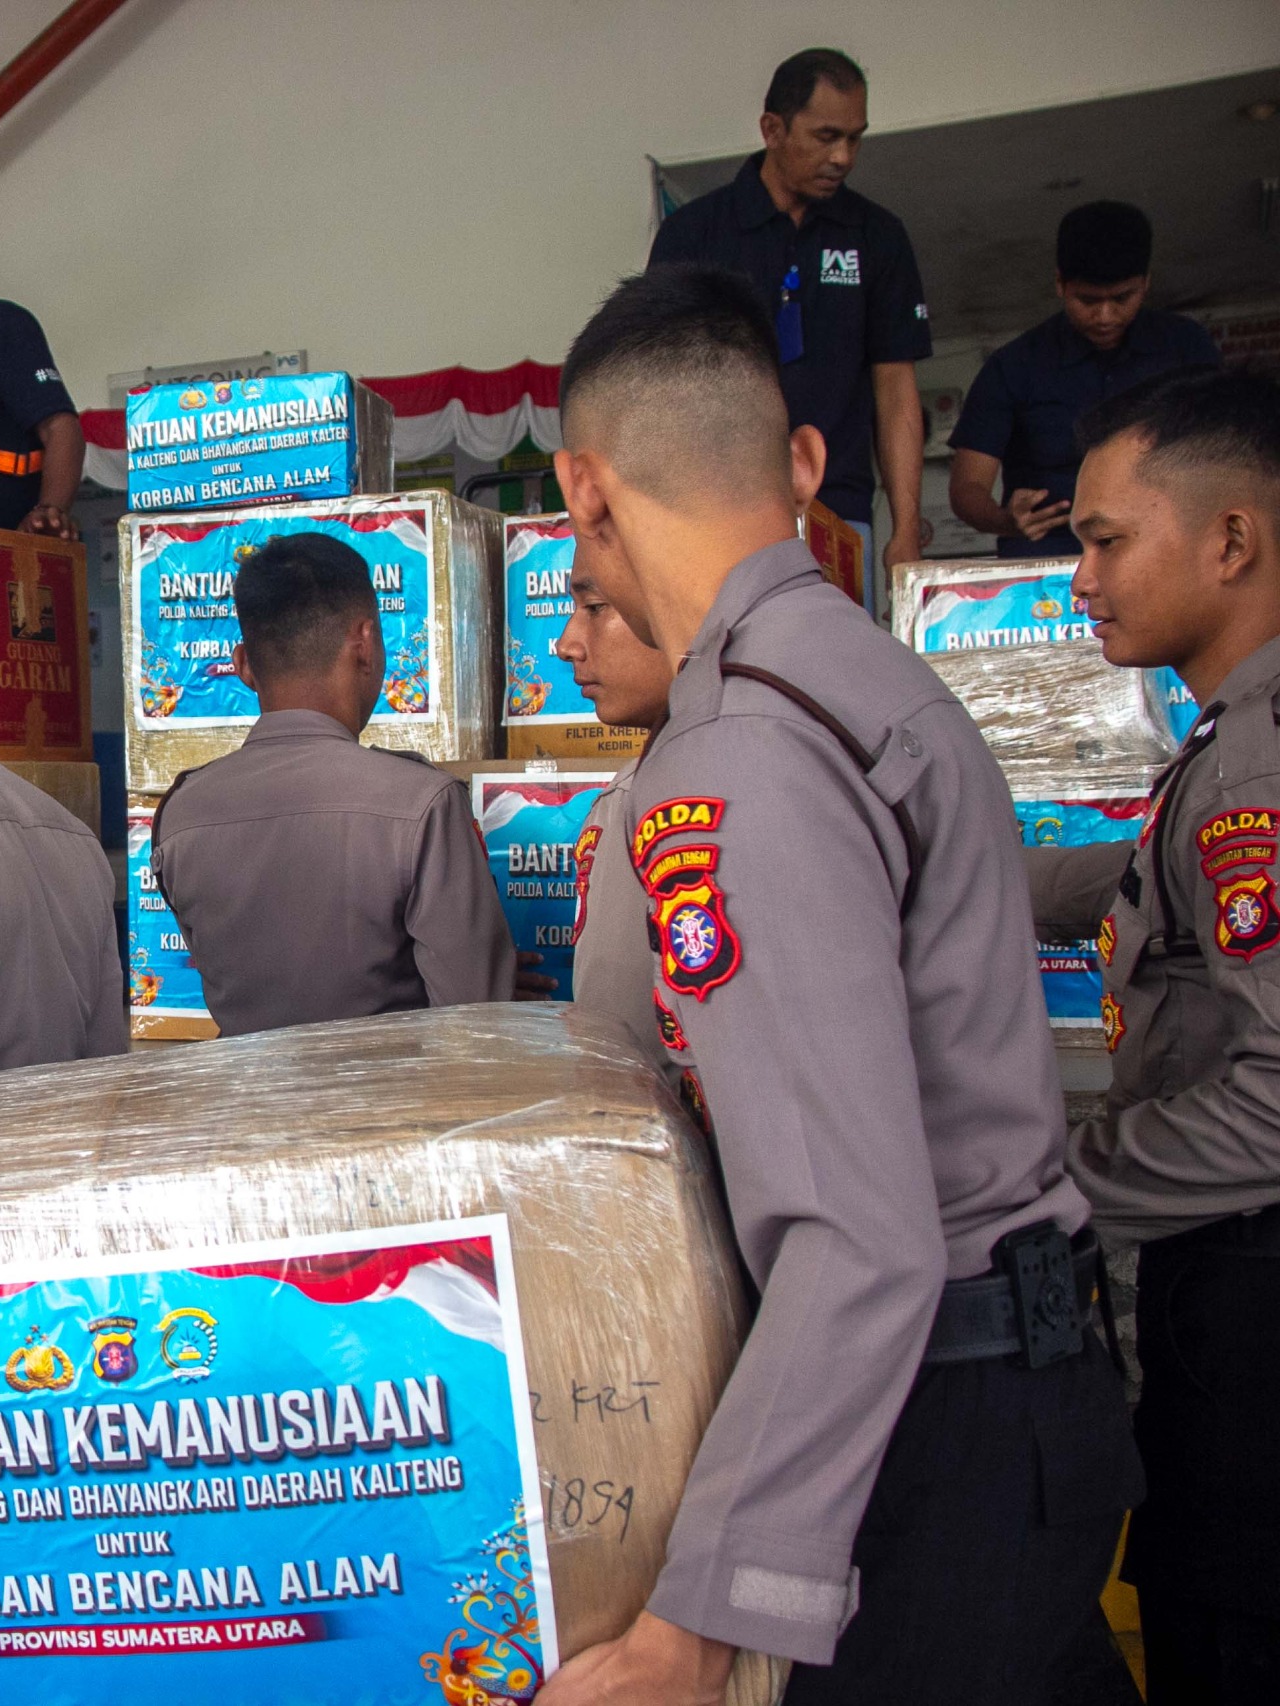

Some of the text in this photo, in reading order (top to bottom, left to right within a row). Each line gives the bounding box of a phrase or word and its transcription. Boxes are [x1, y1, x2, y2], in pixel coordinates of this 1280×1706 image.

[127, 394, 348, 451] NTUAN KEMANUSIAAN
[137, 450, 177, 469] KALTENG
[180, 448, 200, 463] DAN
[202, 437, 268, 460] BHAYANGKARI
[270, 430, 309, 450] DAERAH
[212, 463, 242, 475] UNTUK
[131, 465, 331, 509] KORBAN BENCANA ALAM
[160, 572, 237, 599] BANTUA
[159, 606, 186, 619] POLDA
[189, 603, 228, 619] KALTENG
[525, 602, 555, 617] POLDA
[7, 642, 62, 663] GUDANG
[180, 639, 243, 659] KORBA
[566, 727, 604, 739] FILTER
[597, 740, 633, 751] KEDIRI
[635, 804, 711, 855] POLDA
[1201, 813, 1272, 845] POLDA
[682, 850, 711, 866] TENGAH
[1244, 847, 1272, 858] TENGAH
[507, 882, 577, 897] POLDA KALT
[140, 897, 166, 911] POLDA
[1050, 960, 1088, 969] UTARA
[63, 1375, 445, 1463] KEMANUSIAAN
[14, 1487, 62, 1517] DAN
[69, 1477, 236, 1516] BHAYANGKARI
[243, 1468, 343, 1506] DAERAH
[350, 1456, 461, 1496] KALTENG
[95, 1531, 170, 1555] UNTUK
[69, 1565, 260, 1611] BENCANA
[280, 1553, 399, 1601] ALAM
[104, 1626, 222, 1648] SUMATERA
[227, 1619, 305, 1642] UTARA
